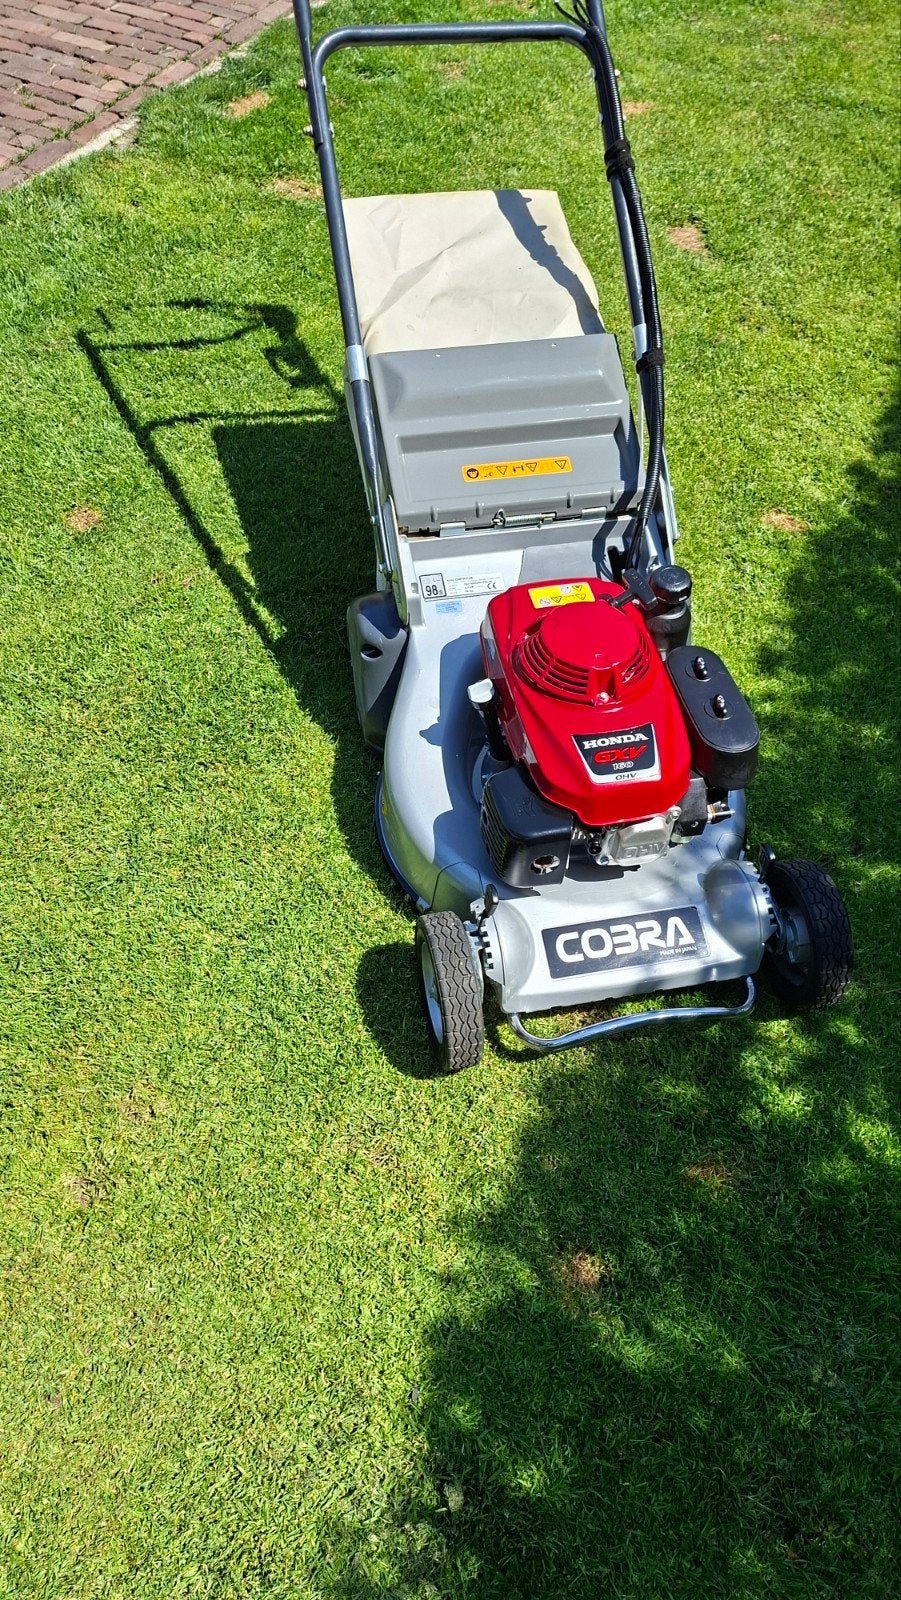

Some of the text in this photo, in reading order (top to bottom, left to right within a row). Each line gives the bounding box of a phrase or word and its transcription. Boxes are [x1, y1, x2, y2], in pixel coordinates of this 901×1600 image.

[426, 585, 439, 597] 98
[582, 733, 650, 750] HONDA
[593, 745, 647, 765] GXV
[612, 760, 634, 771] 160
[615, 772, 637, 781] OHV
[623, 841, 668, 859] OHV
[555, 916, 696, 963] COBRA
[682, 945, 698, 954] JAPAN
